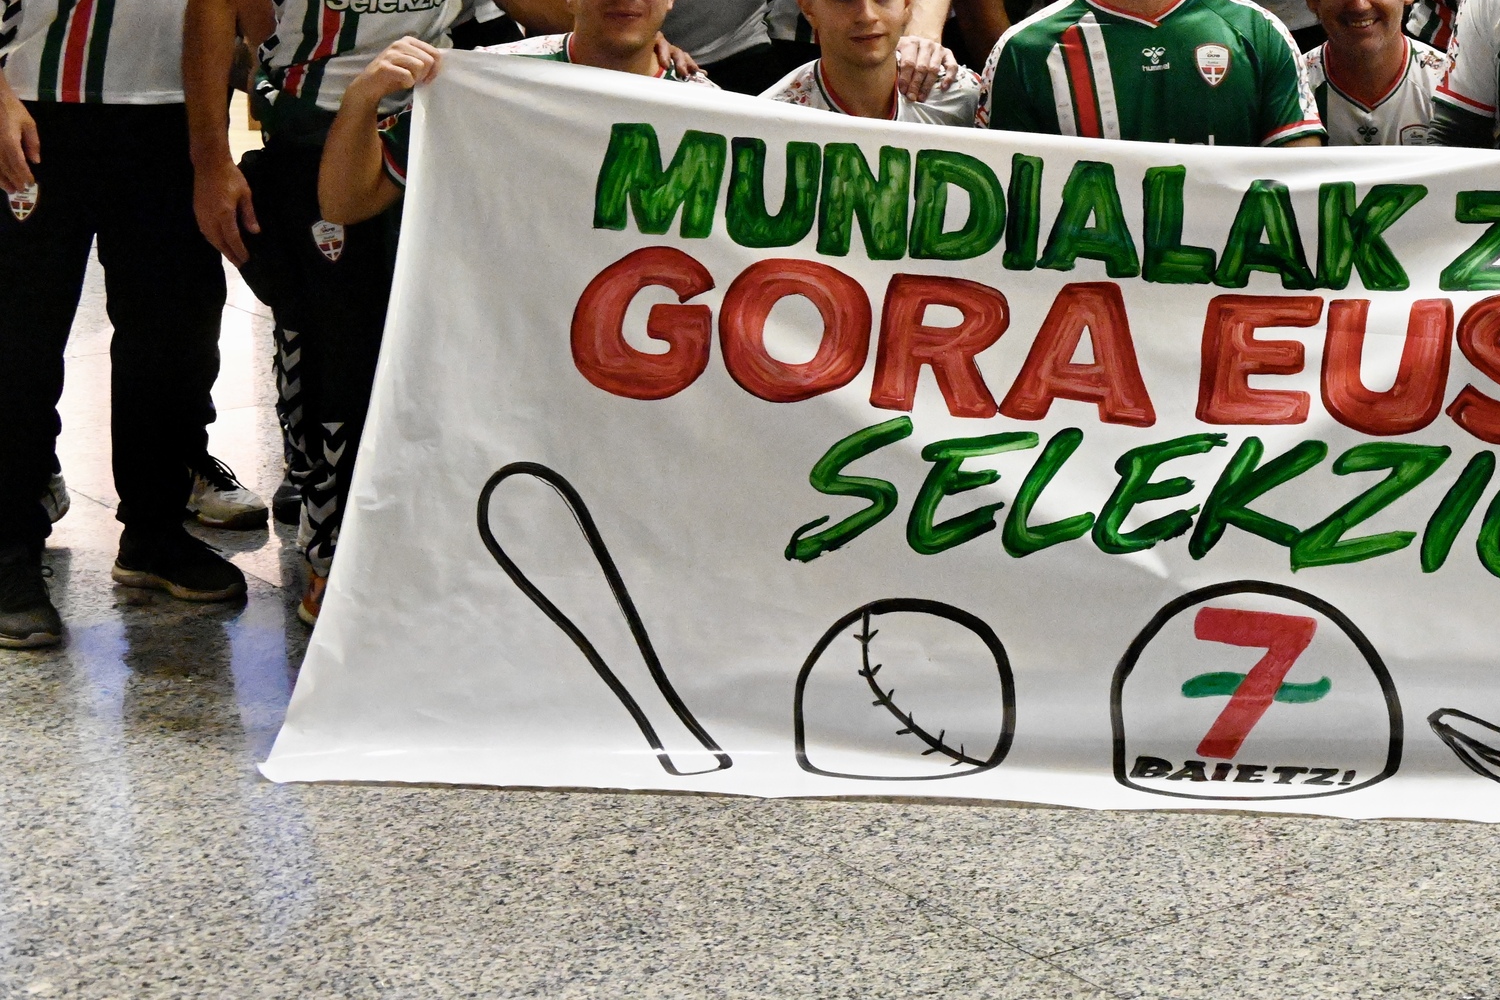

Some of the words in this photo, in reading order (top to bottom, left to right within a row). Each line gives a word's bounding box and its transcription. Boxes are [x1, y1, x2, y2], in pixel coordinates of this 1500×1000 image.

[1142, 63, 1170, 72] hummel
[592, 122, 1428, 290] MUNDIALAK
[570, 245, 1156, 427] GORA
[1181, 607, 1332, 760] 7
[1130, 756, 1356, 785] BAIETZ!
